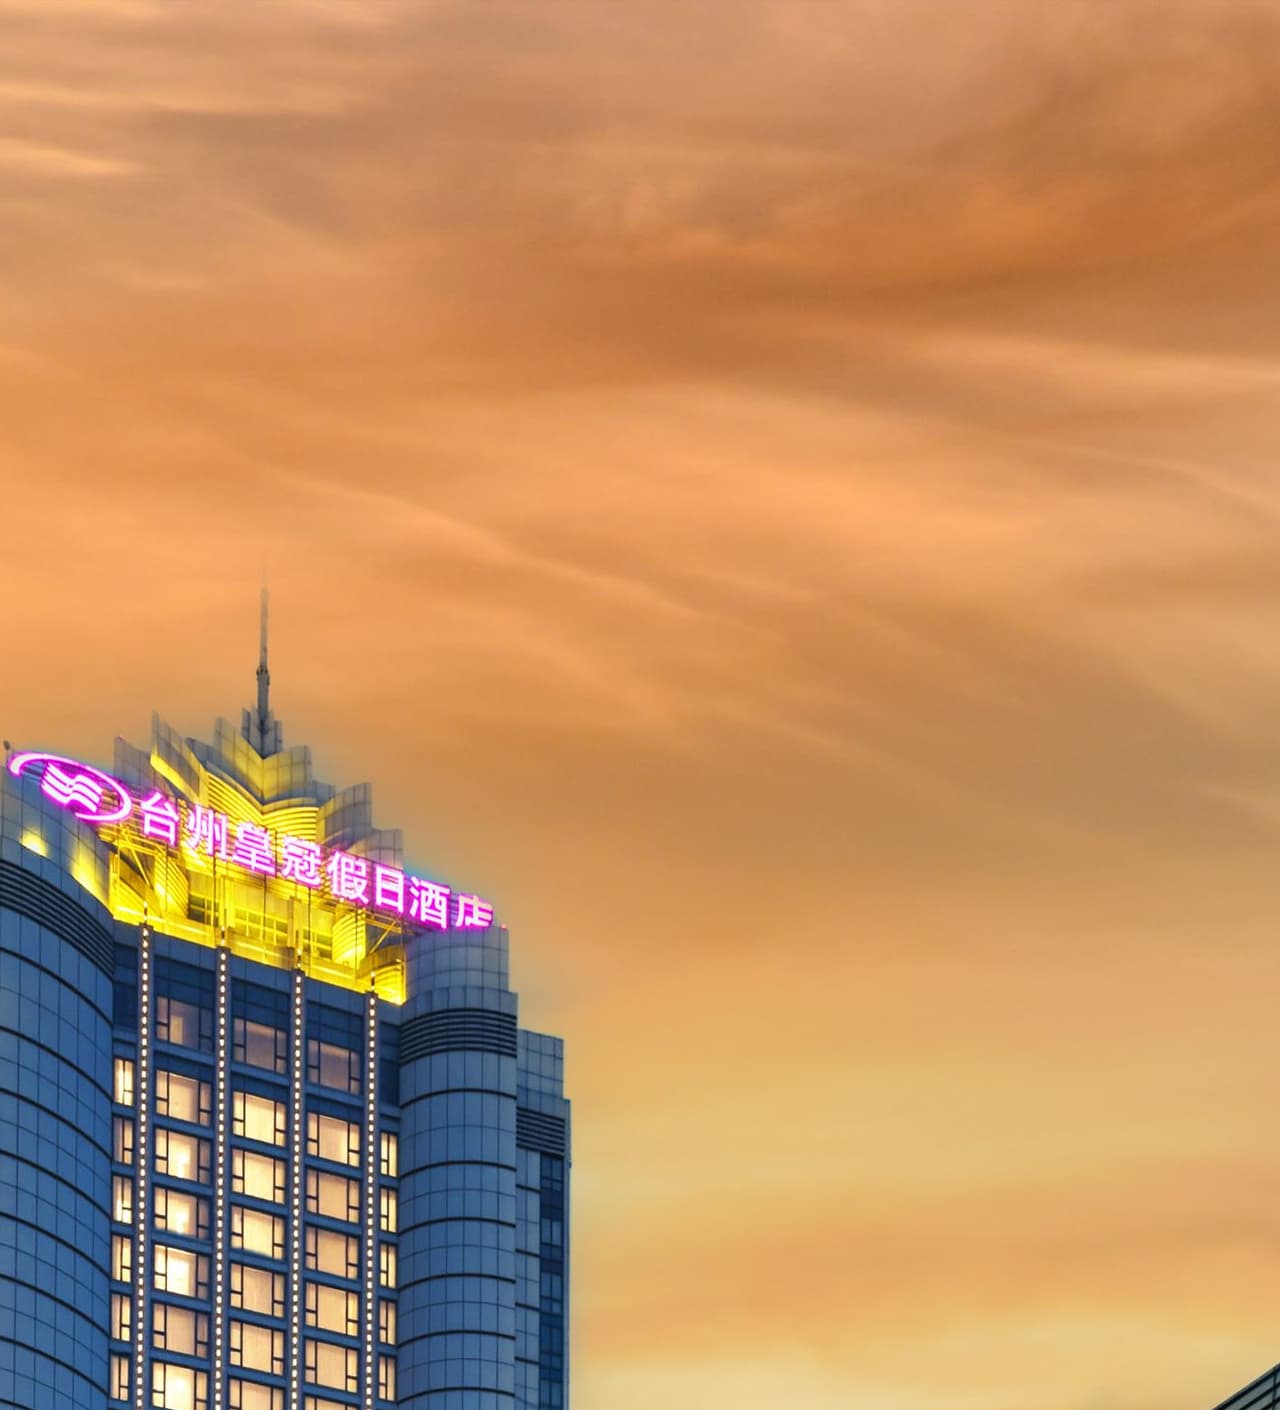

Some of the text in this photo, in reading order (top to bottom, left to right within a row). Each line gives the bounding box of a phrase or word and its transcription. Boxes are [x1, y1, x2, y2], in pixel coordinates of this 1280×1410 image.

[139, 792, 494, 929] 台州皇冠假日酒店
